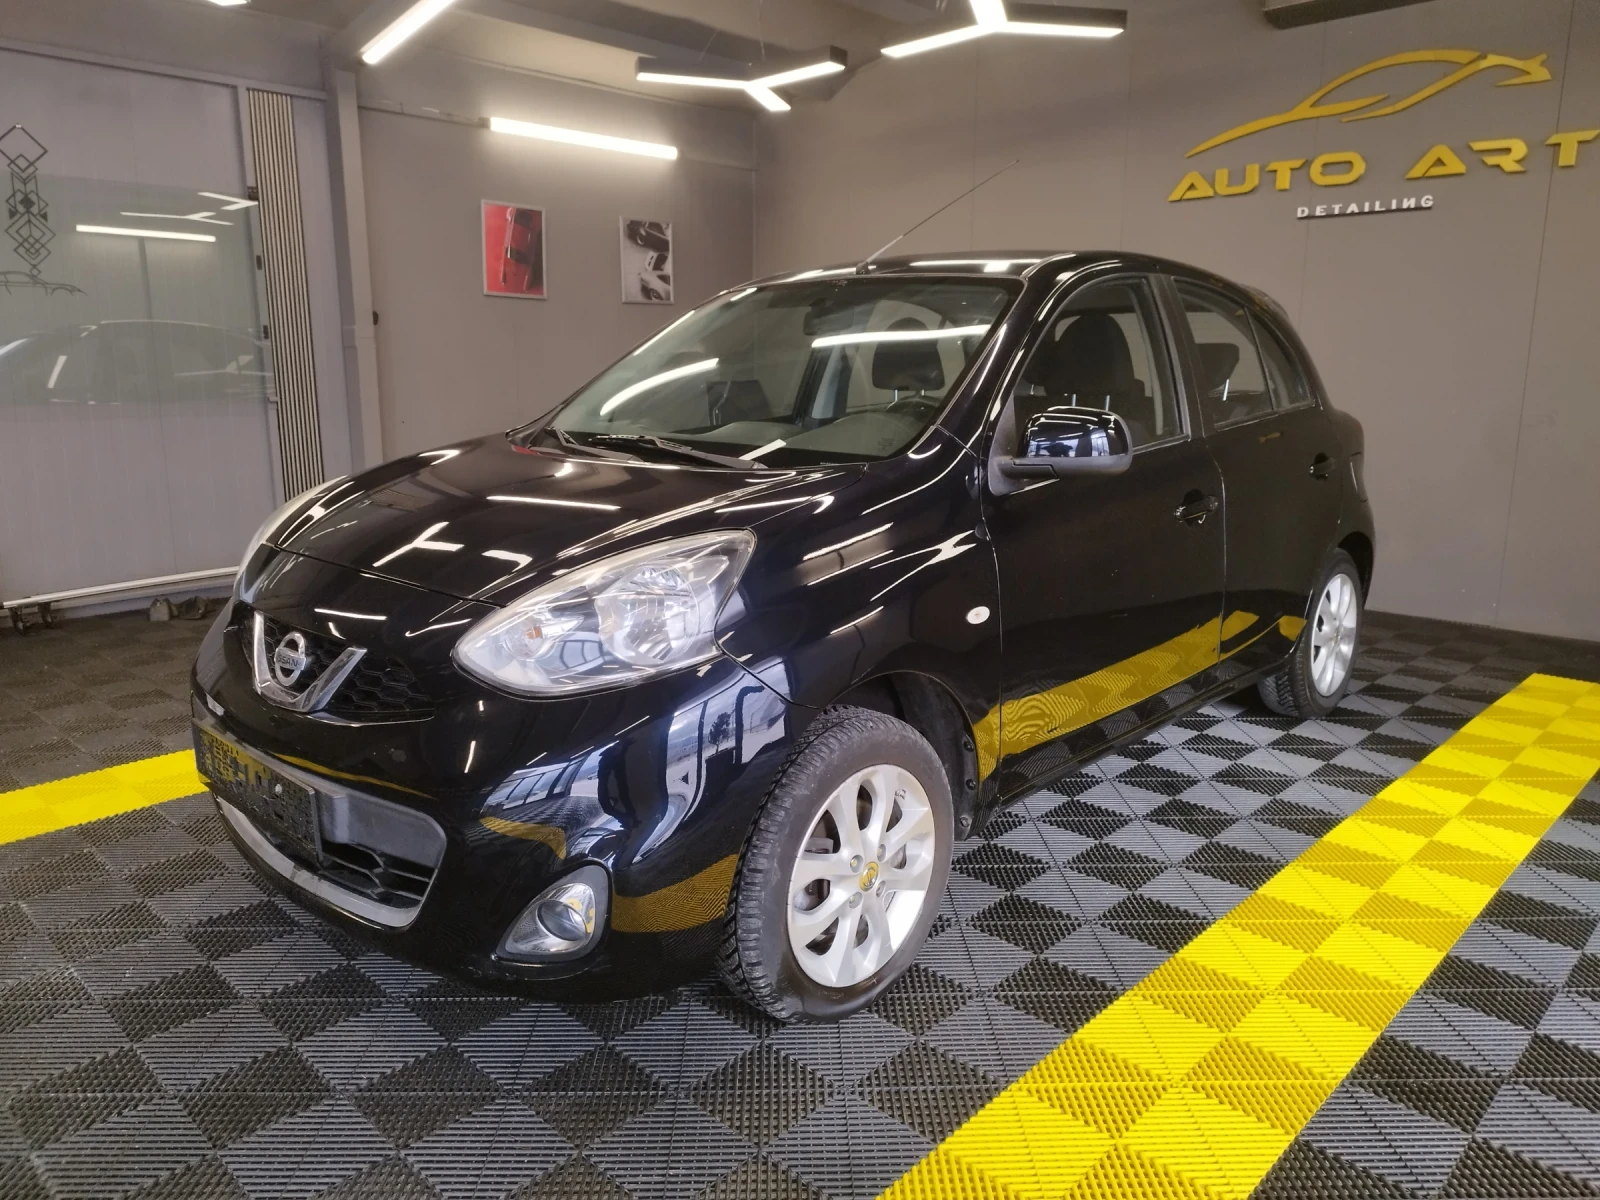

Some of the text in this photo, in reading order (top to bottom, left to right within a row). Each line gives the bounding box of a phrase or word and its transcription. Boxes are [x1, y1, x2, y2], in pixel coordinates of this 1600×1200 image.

[1168, 129, 1600, 202] AUTO ART
[1297, 195, 1434, 218] DETAILING
